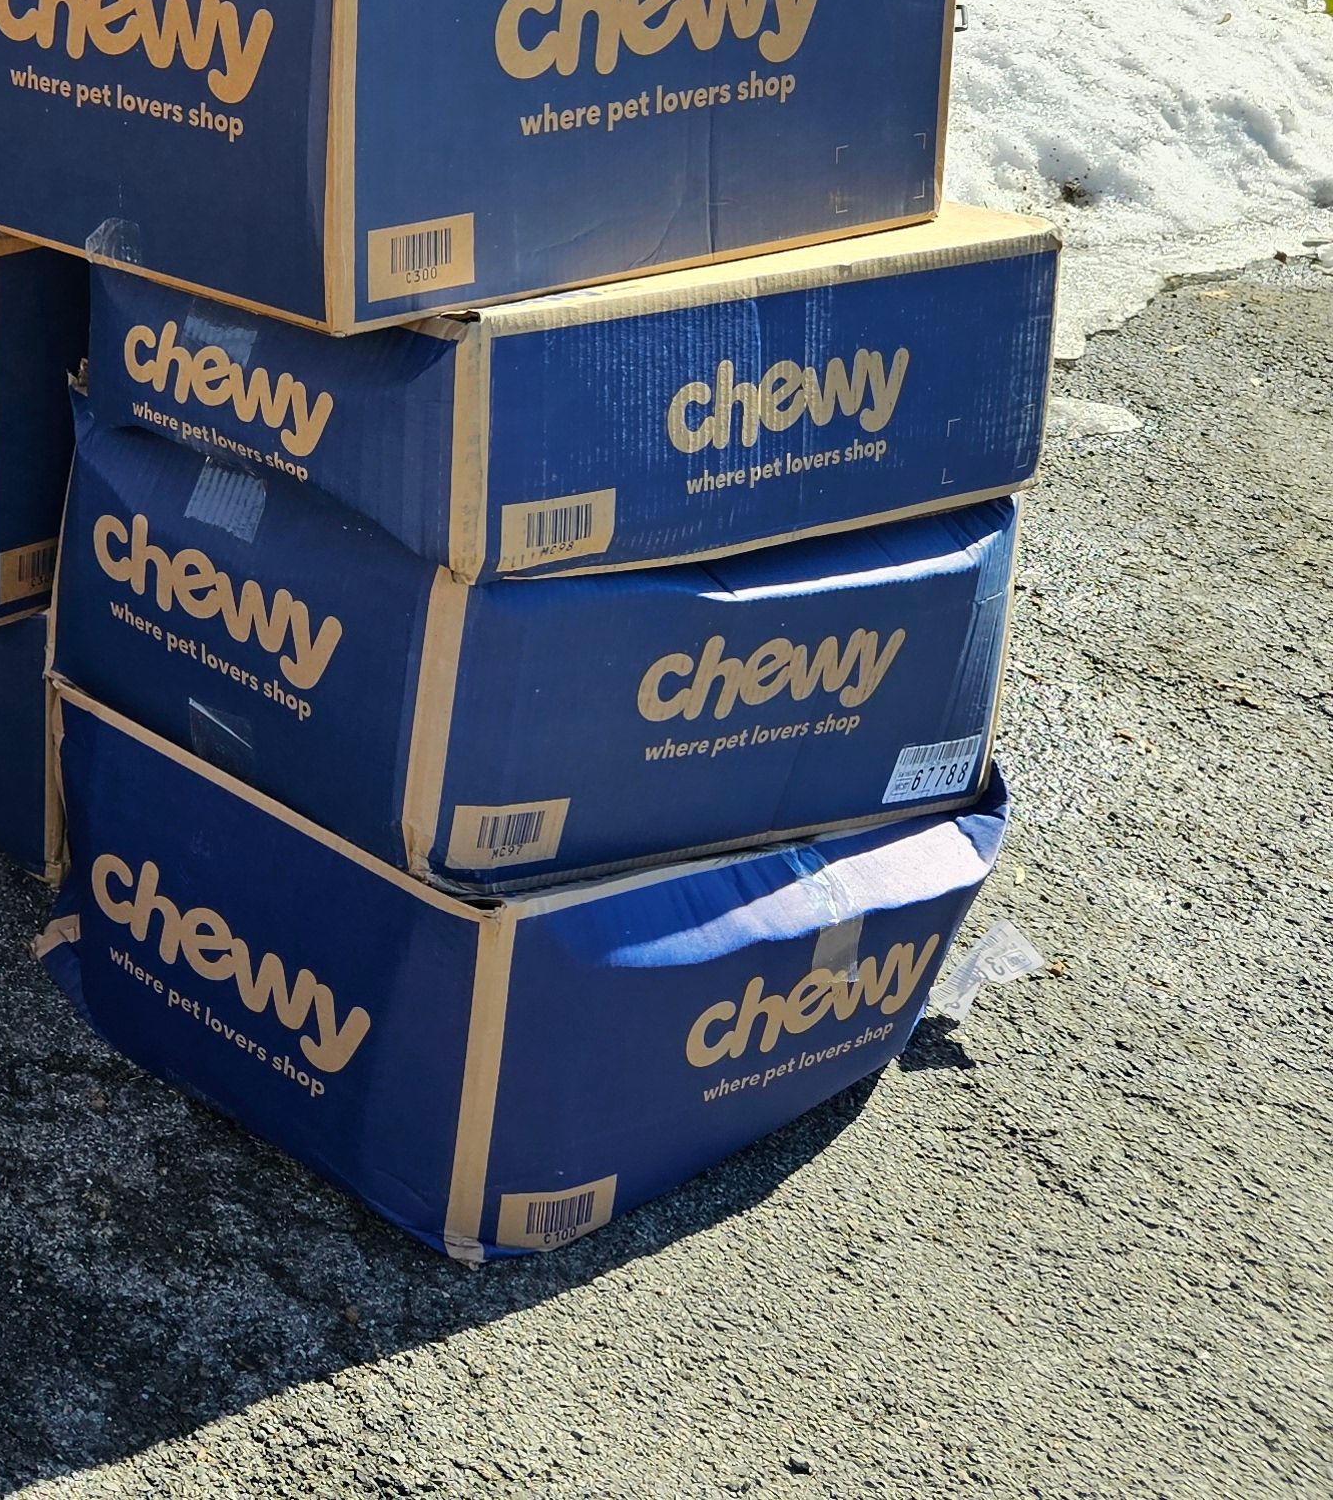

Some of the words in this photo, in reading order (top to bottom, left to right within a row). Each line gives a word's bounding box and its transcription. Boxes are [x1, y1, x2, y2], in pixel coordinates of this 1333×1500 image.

[10, 65, 71, 97] where
[76, 83, 111, 107] pet
[117, 84, 183, 123] lovers
[189, 102, 244, 142] shop
[520, 103, 601, 136] where
[607, 91, 650, 131] pet
[655, 85, 731, 114] lovers
[737, 70, 796, 103] shop
[405, 267, 438, 284] C300
[124, 320, 333, 457] chewy
[667, 347, 909, 453] chewy
[132, 401, 179, 430] where
[181, 420, 210, 443] pet
[212, 428, 263, 463] lovers
[265, 452, 309, 483] shop
[686, 469, 745, 495] where
[749, 458, 782, 488] pet
[786, 447, 841, 474] lovers
[844, 438, 887, 462] shop
[541, 541, 574, 557] MC98
[93, 513, 343, 689] chewy
[110, 601, 162, 640] where
[166, 632, 197, 659] pet
[201, 643, 259, 690] lovers
[263, 680, 312, 721] shop
[637, 628, 906, 722] chewy
[645, 738, 709, 761] where
[712, 730, 748, 758] pet
[751, 720, 809, 745] lovers
[814, 713, 861, 736] shop
[910, 761, 969, 791] 67788
[491, 845, 522, 860] MC97
[91, 853, 371, 1073] chewy
[685, 933, 940, 1068] chewy
[109, 946, 163, 994] where
[167, 988, 201, 1020] pet
[205, 1007, 267, 1062] lovers
[272, 1055, 325, 1098] shop
[702, 1073, 759, 1102] where
[761, 1059, 796, 1085] pet
[798, 1038, 852, 1070] lovers
[854, 1022, 894, 1049] shop
[544, 1226, 576, 1244] C100
